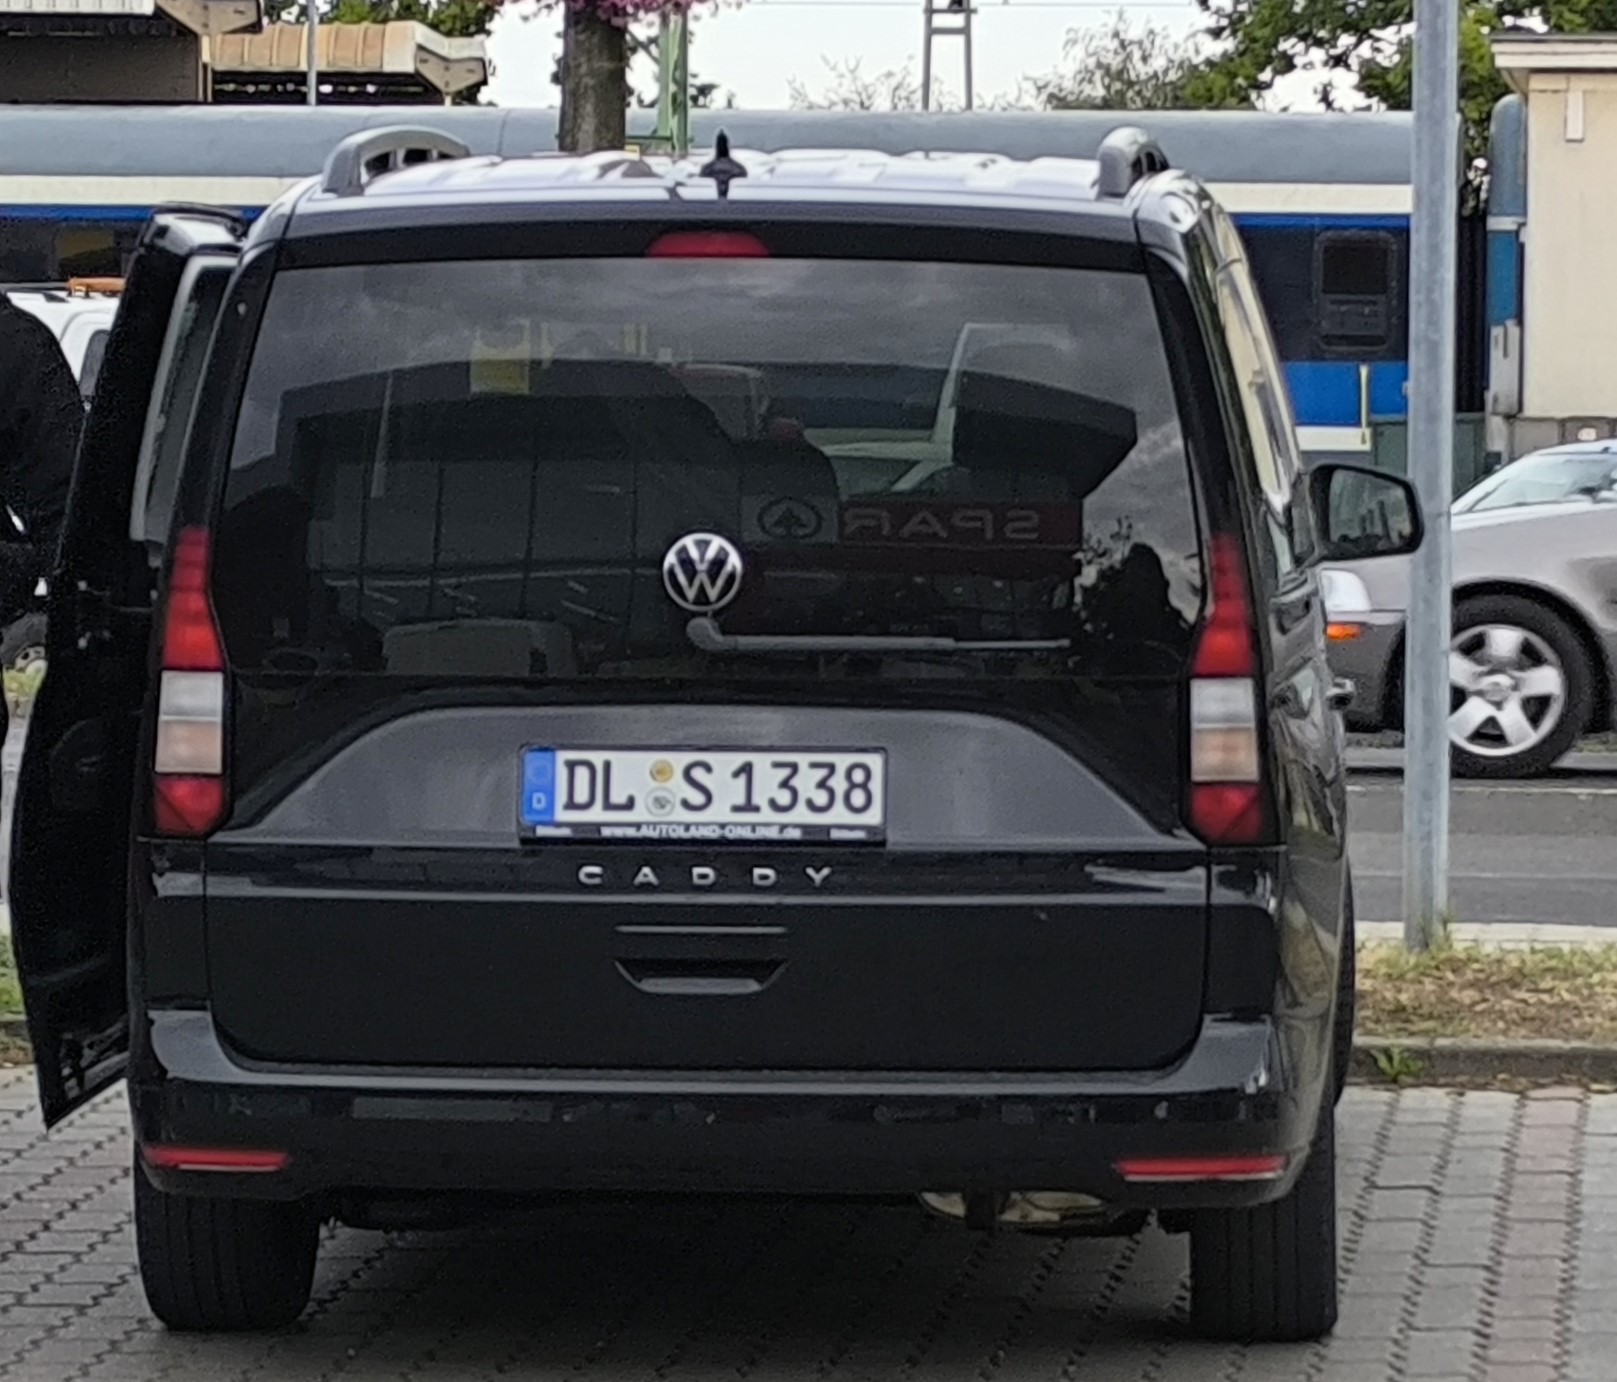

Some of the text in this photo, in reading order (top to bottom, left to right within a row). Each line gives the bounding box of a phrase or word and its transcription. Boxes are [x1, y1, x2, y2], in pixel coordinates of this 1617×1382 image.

[563, 759, 873, 814] DL S 1338
[532, 792, 546, 810] D
[578, 865, 832, 887] CADDY
